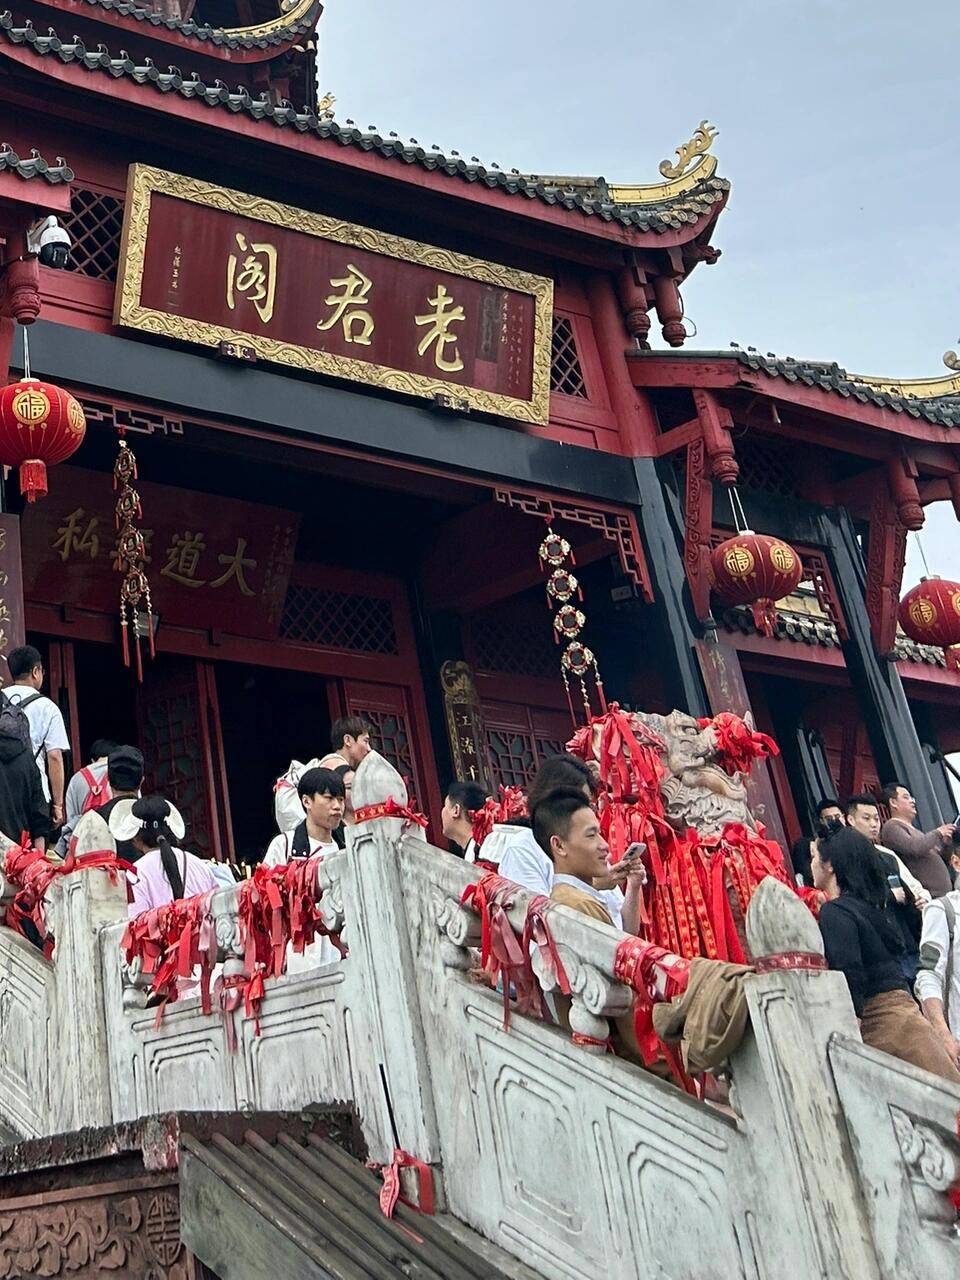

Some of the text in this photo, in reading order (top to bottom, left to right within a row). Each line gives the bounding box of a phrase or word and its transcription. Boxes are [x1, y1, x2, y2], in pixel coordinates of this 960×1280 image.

[17, 394, 46, 420] 福
[726, 549, 750, 573] 福
[774, 548, 794, 570] 福
[912, 602, 932, 624] 福
